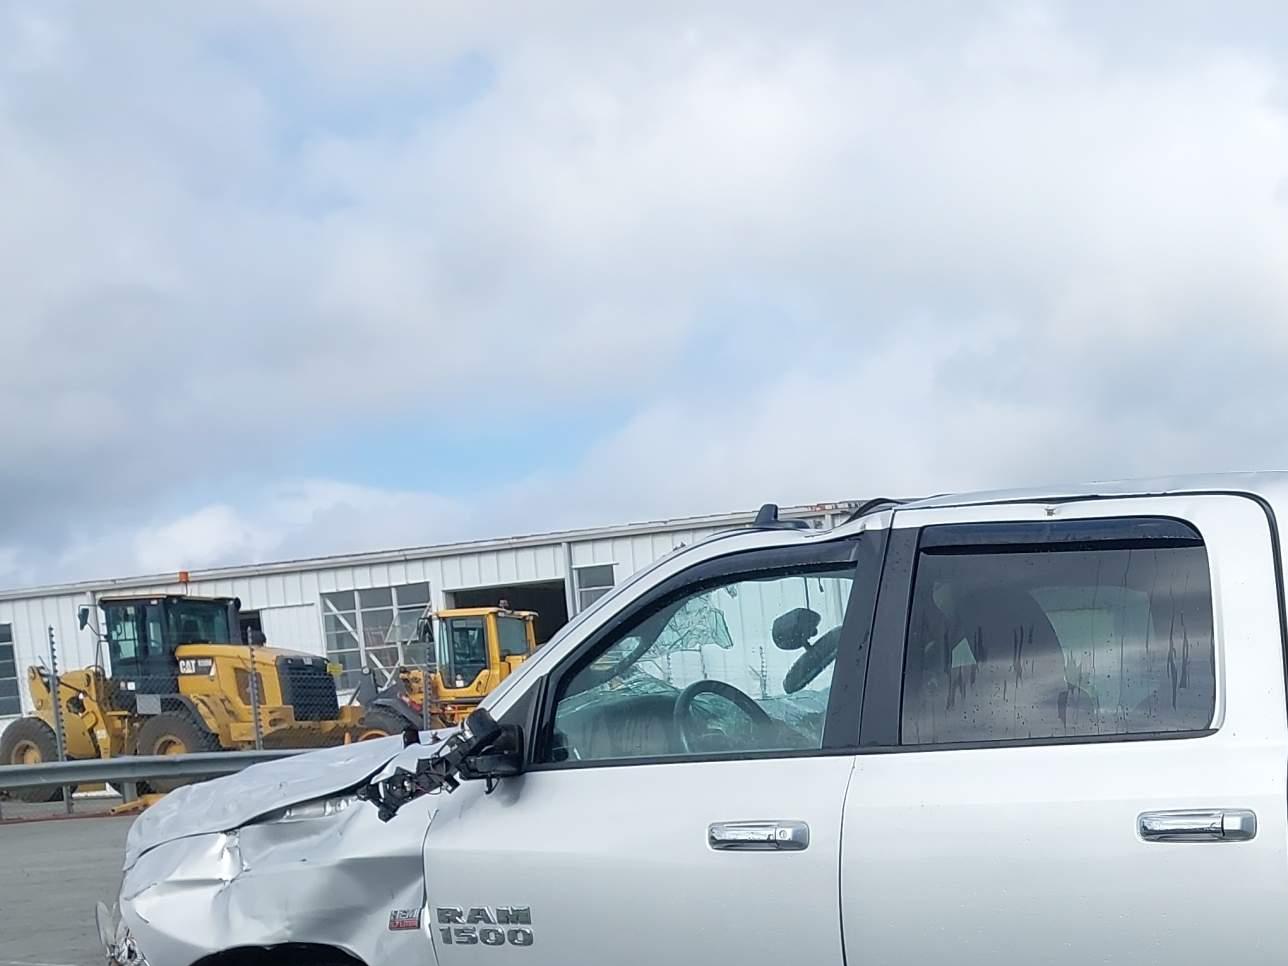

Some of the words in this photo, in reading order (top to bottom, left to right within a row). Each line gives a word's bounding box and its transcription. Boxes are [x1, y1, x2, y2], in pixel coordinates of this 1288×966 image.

[179, 659, 196, 674] CAT
[437, 907, 532, 924] RAM
[438, 927, 534, 946] 1500
